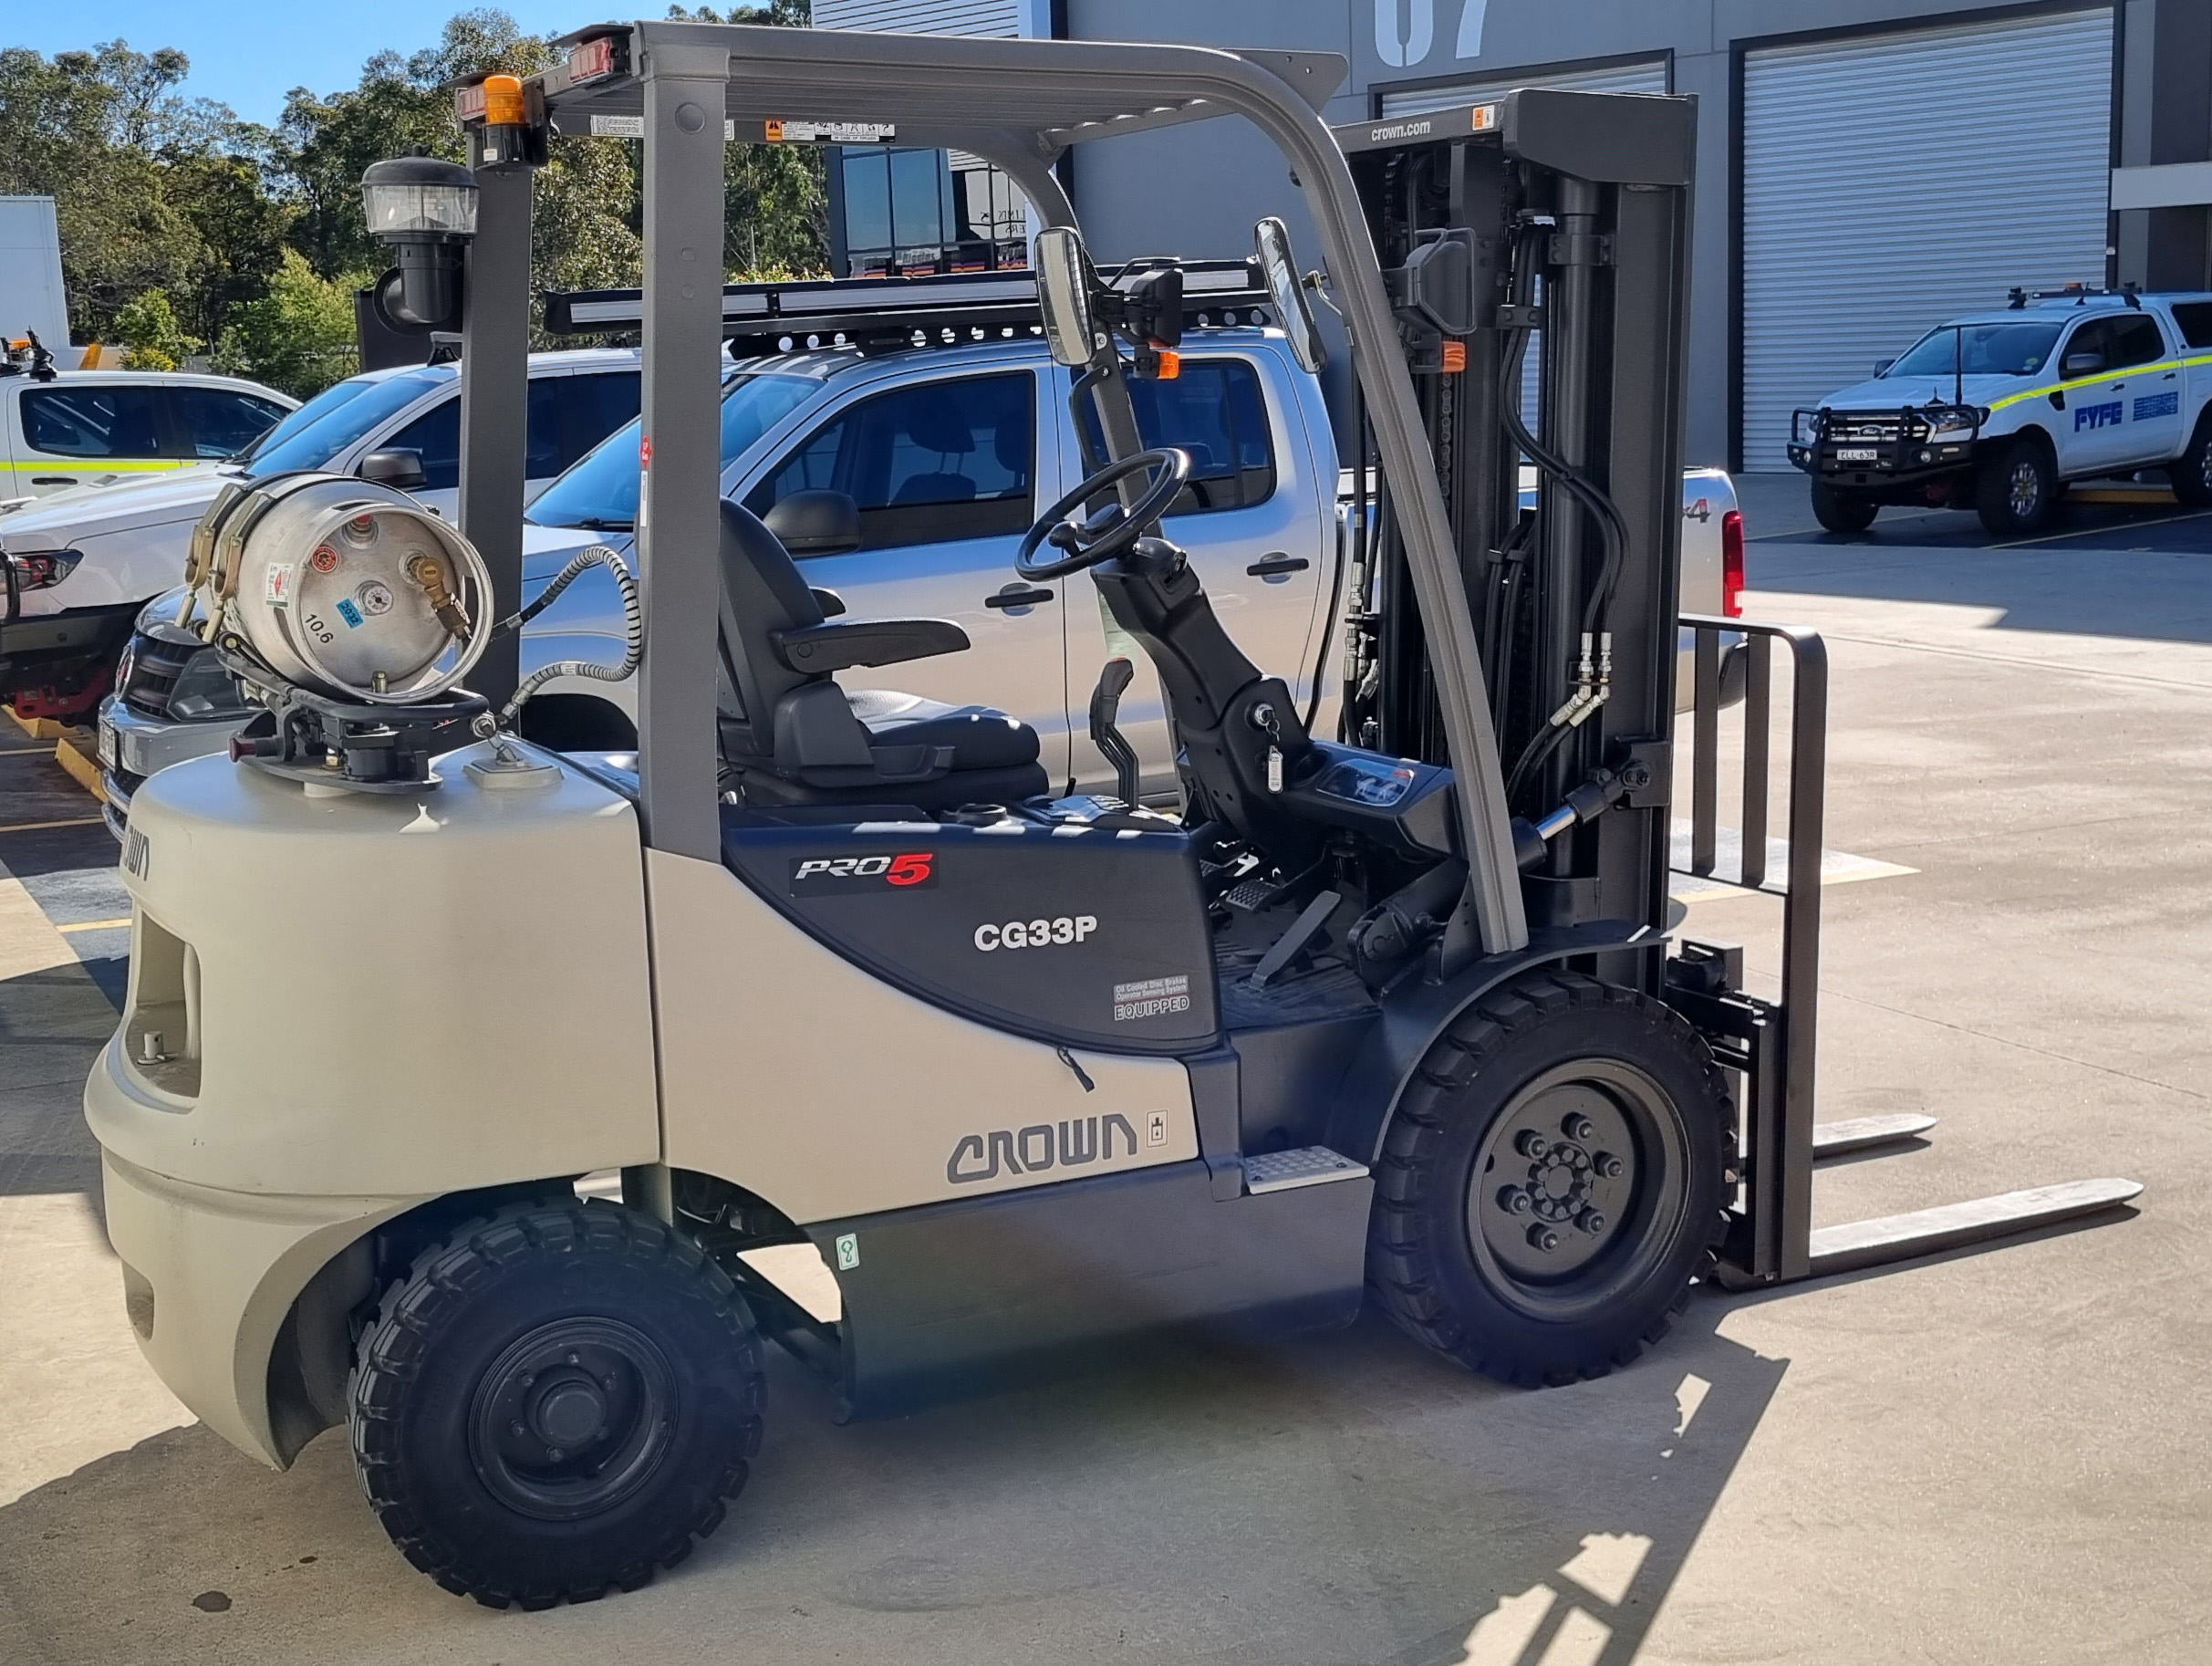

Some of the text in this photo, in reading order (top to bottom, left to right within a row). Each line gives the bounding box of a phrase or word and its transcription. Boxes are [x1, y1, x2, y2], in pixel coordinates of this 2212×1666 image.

[1371, 121, 1430, 141] crown.com
[2074, 401, 2123, 432] FYFE
[306, 614, 333, 643] 10.6
[974, 915, 1097, 952] CG33P
[1115, 995, 1189, 1021] EQUIPPED
[947, 1113, 1137, 1184] CROWN
